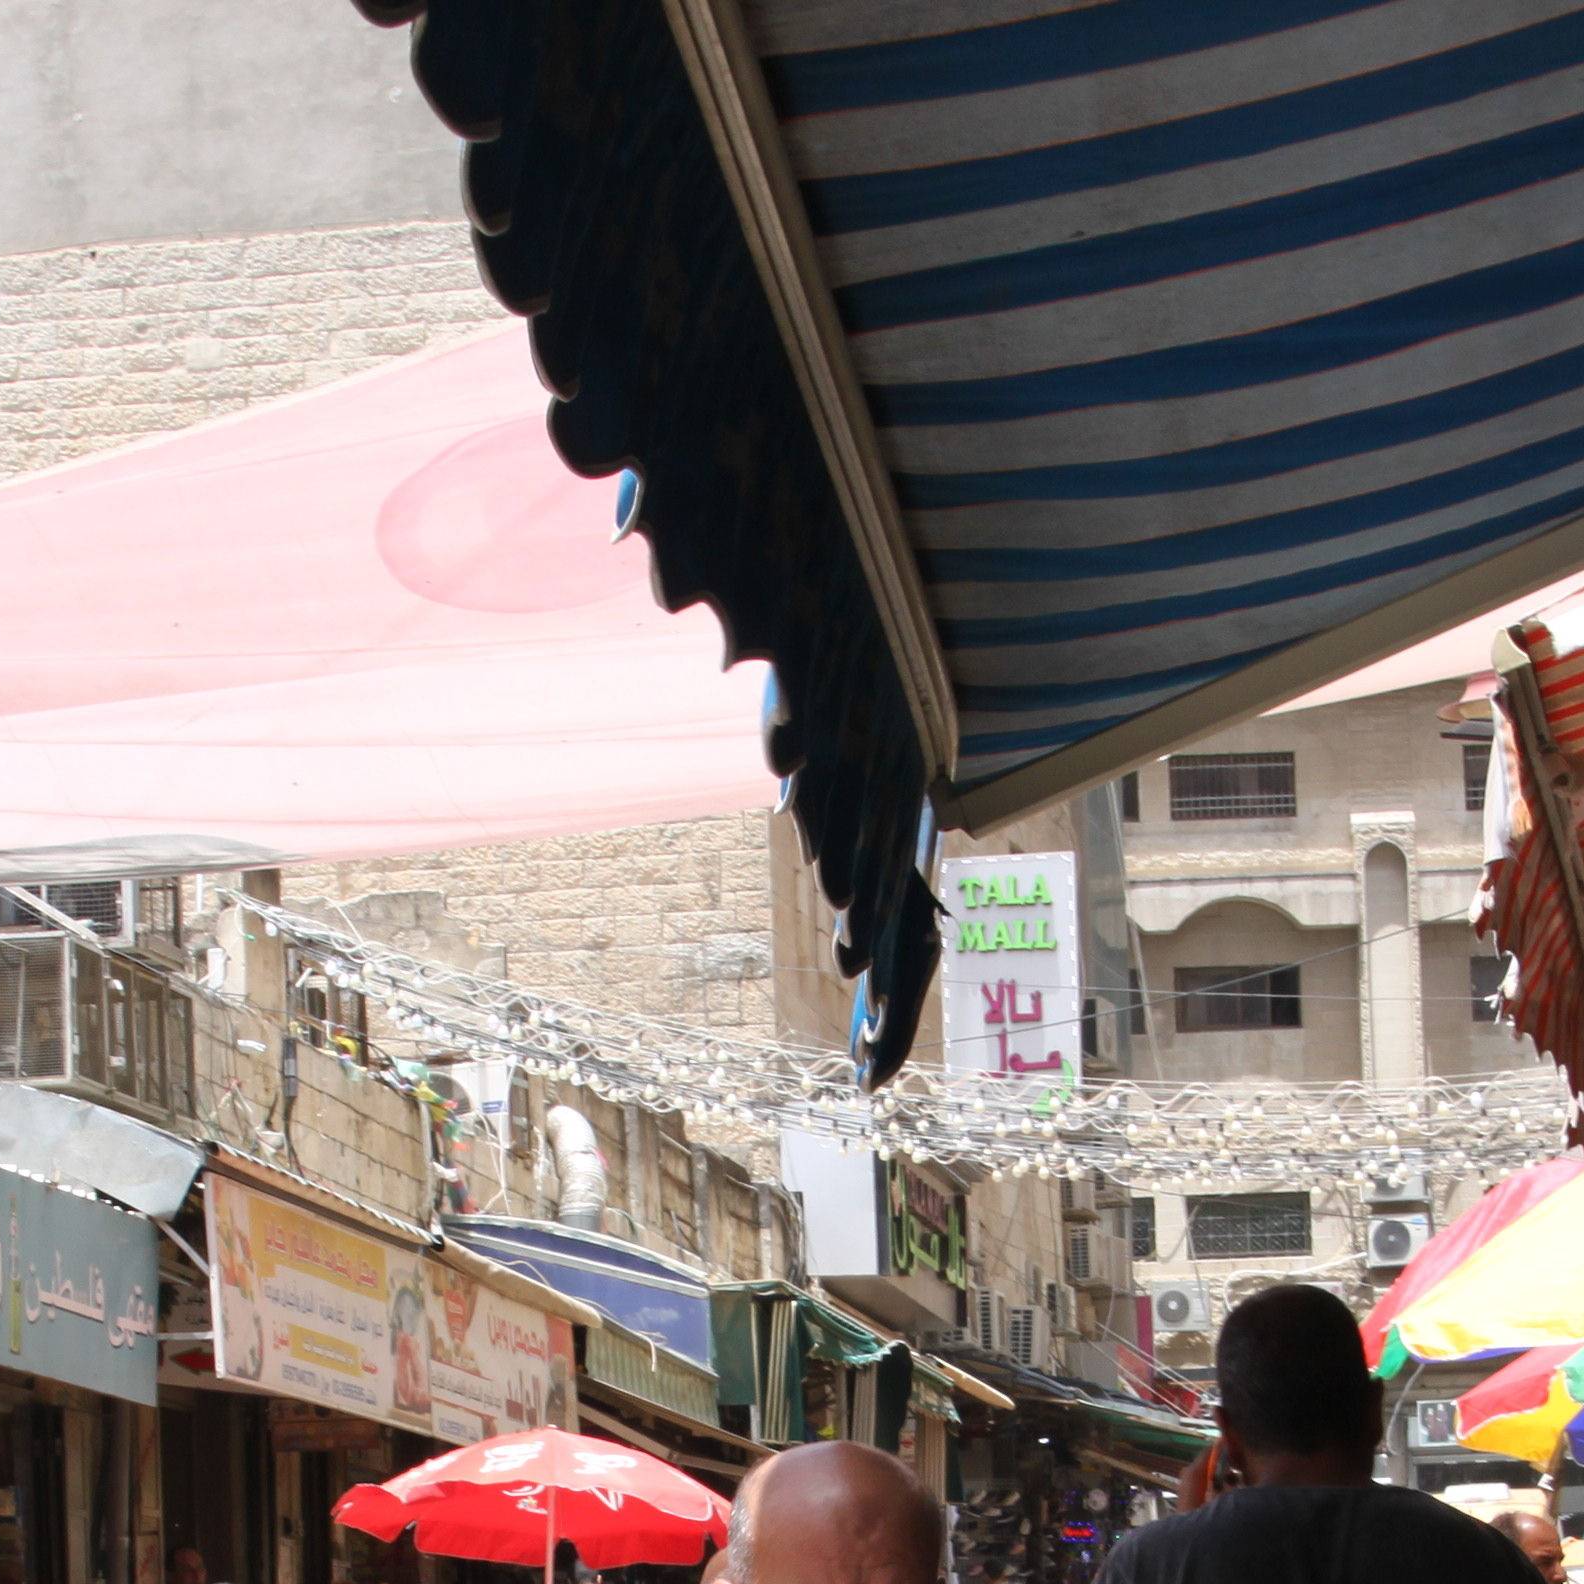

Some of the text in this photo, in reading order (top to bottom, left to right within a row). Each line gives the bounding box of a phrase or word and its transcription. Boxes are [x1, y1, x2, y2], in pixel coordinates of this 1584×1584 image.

[958, 874, 1053, 908] TALA
[956, 919, 1058, 953] MALL
[25, 1250, 106, 1323] فلسطين
